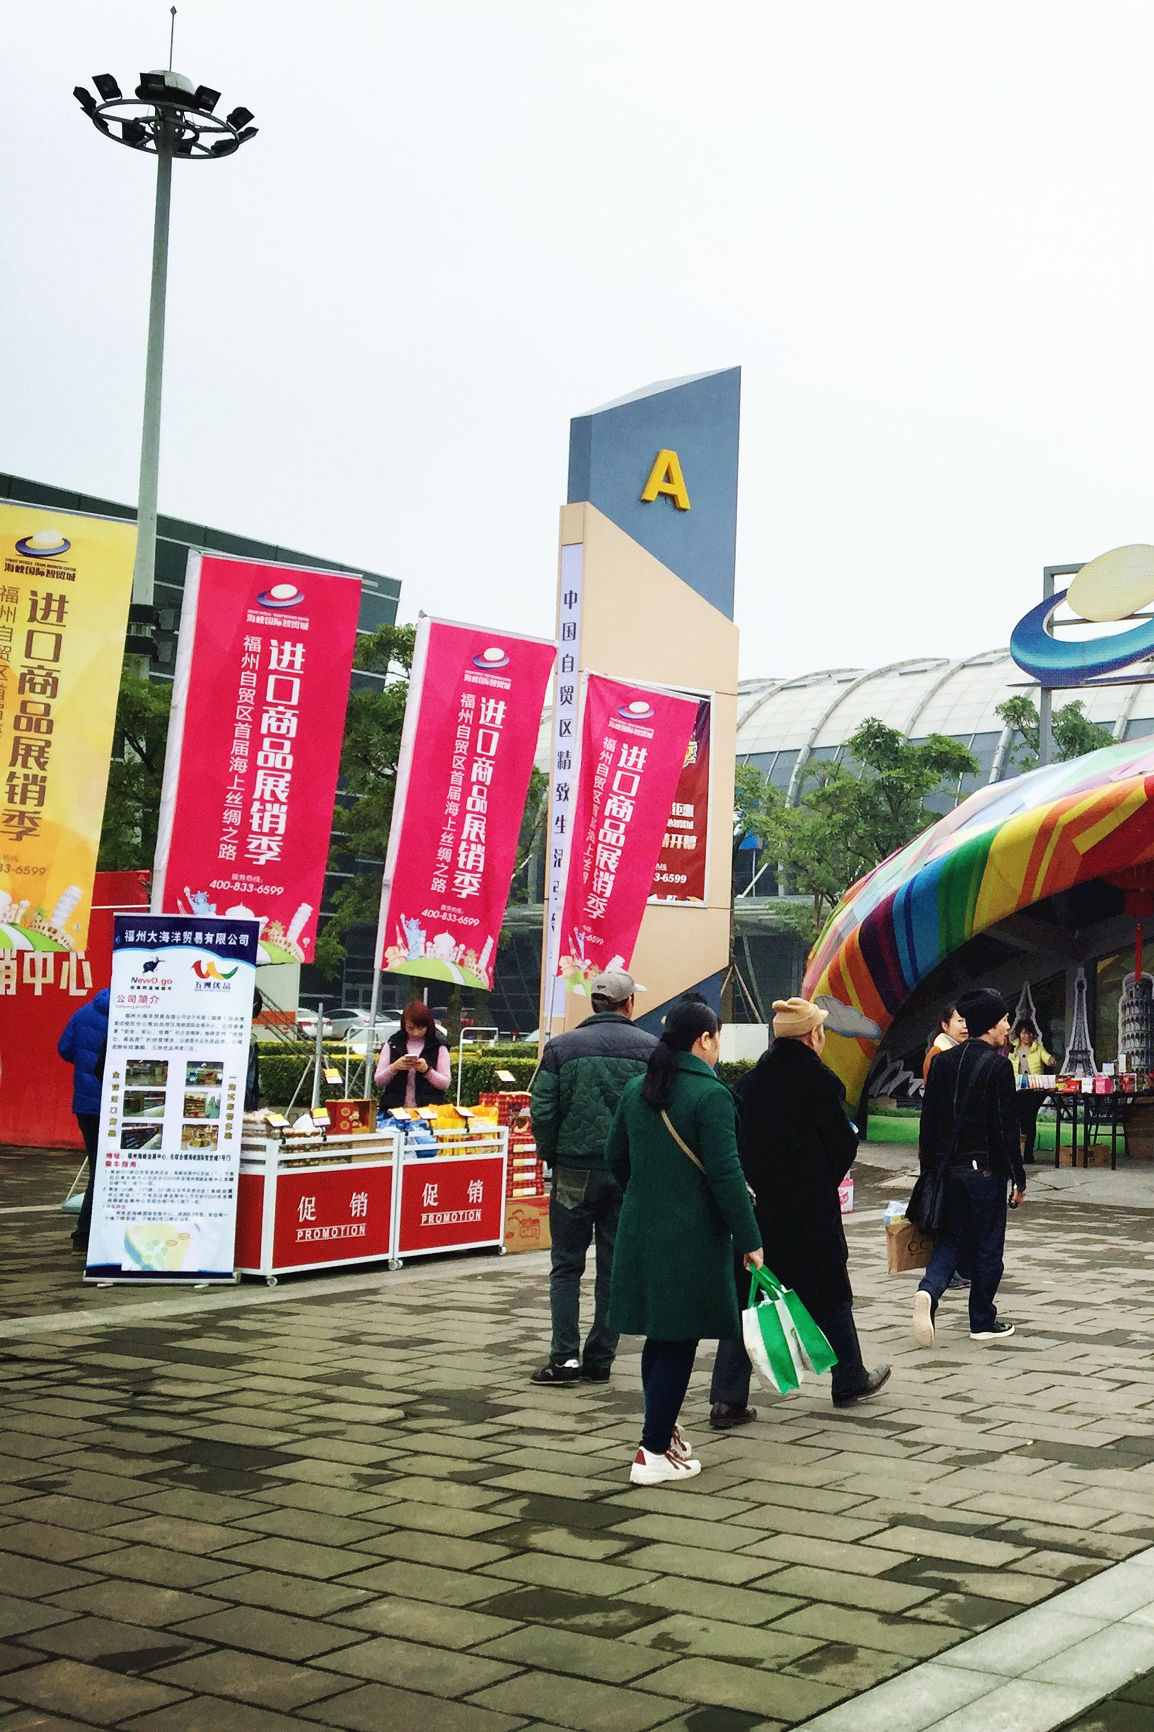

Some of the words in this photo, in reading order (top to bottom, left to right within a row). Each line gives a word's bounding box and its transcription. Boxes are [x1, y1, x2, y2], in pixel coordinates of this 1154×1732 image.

[640, 448, 692, 512] A
[0, 588, 70, 842] 进口商品展销季
[217, 634, 262, 861] 福州自贸区首届海上丝绸之路
[244, 639, 306, 866] 进口商品展销季
[430, 692, 475, 894] 福州自贸区首届海上丝绸之路
[451, 696, 507, 899] 进口商品展销季
[583, 742, 648, 920] 进口商品展销季
[209, 879, 284, 895] 400-833-6599
[124, 929, 249, 947] 福州大海洋贸易有限公司
[421, 909, 480, 927] 400-833-6599
[297, 1191, 369, 1223] 促销
[420, 1208, 482, 1226] PROMOTION
[421, 1179, 484, 1207] 促销
[296, 1223, 367, 1242] PROMOTION
